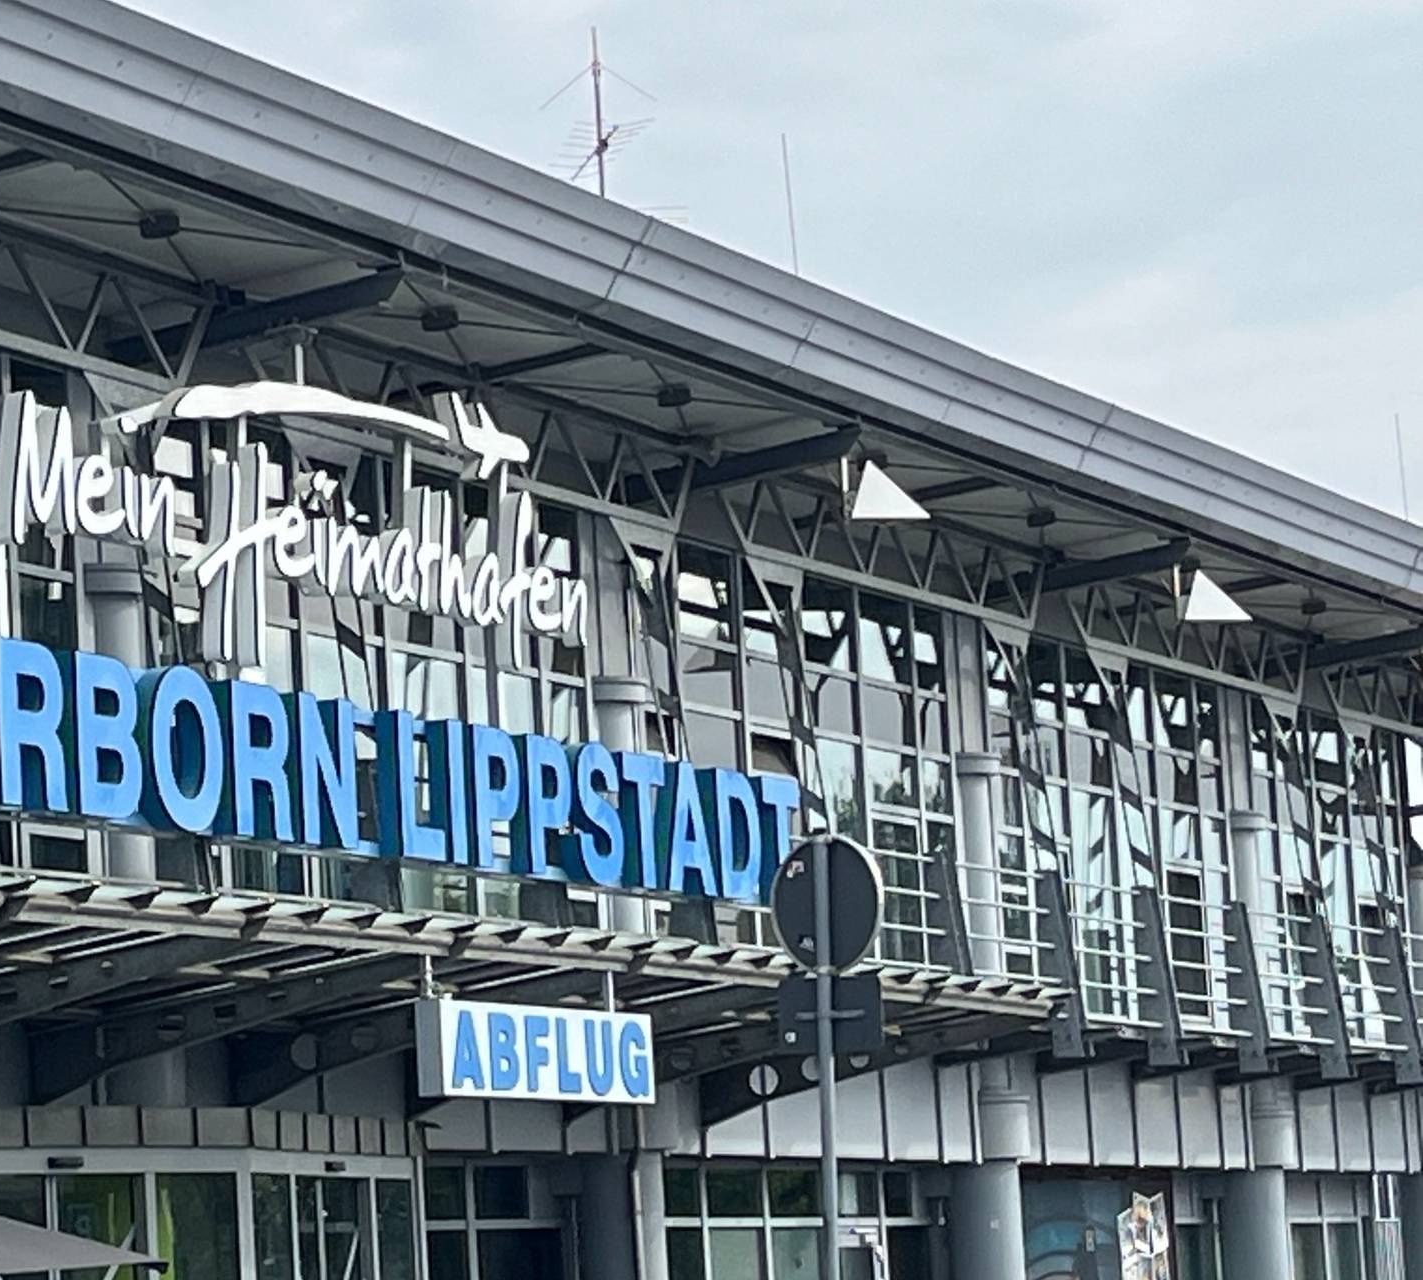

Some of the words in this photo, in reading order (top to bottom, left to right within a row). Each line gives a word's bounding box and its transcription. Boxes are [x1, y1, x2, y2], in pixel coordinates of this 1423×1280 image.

[14, 389, 177, 557] Mein
[197, 441, 587, 669] Heimathafen
[395, 708, 800, 907] LIPPSTADT
[452, 1009, 650, 1098] ABFLUG
